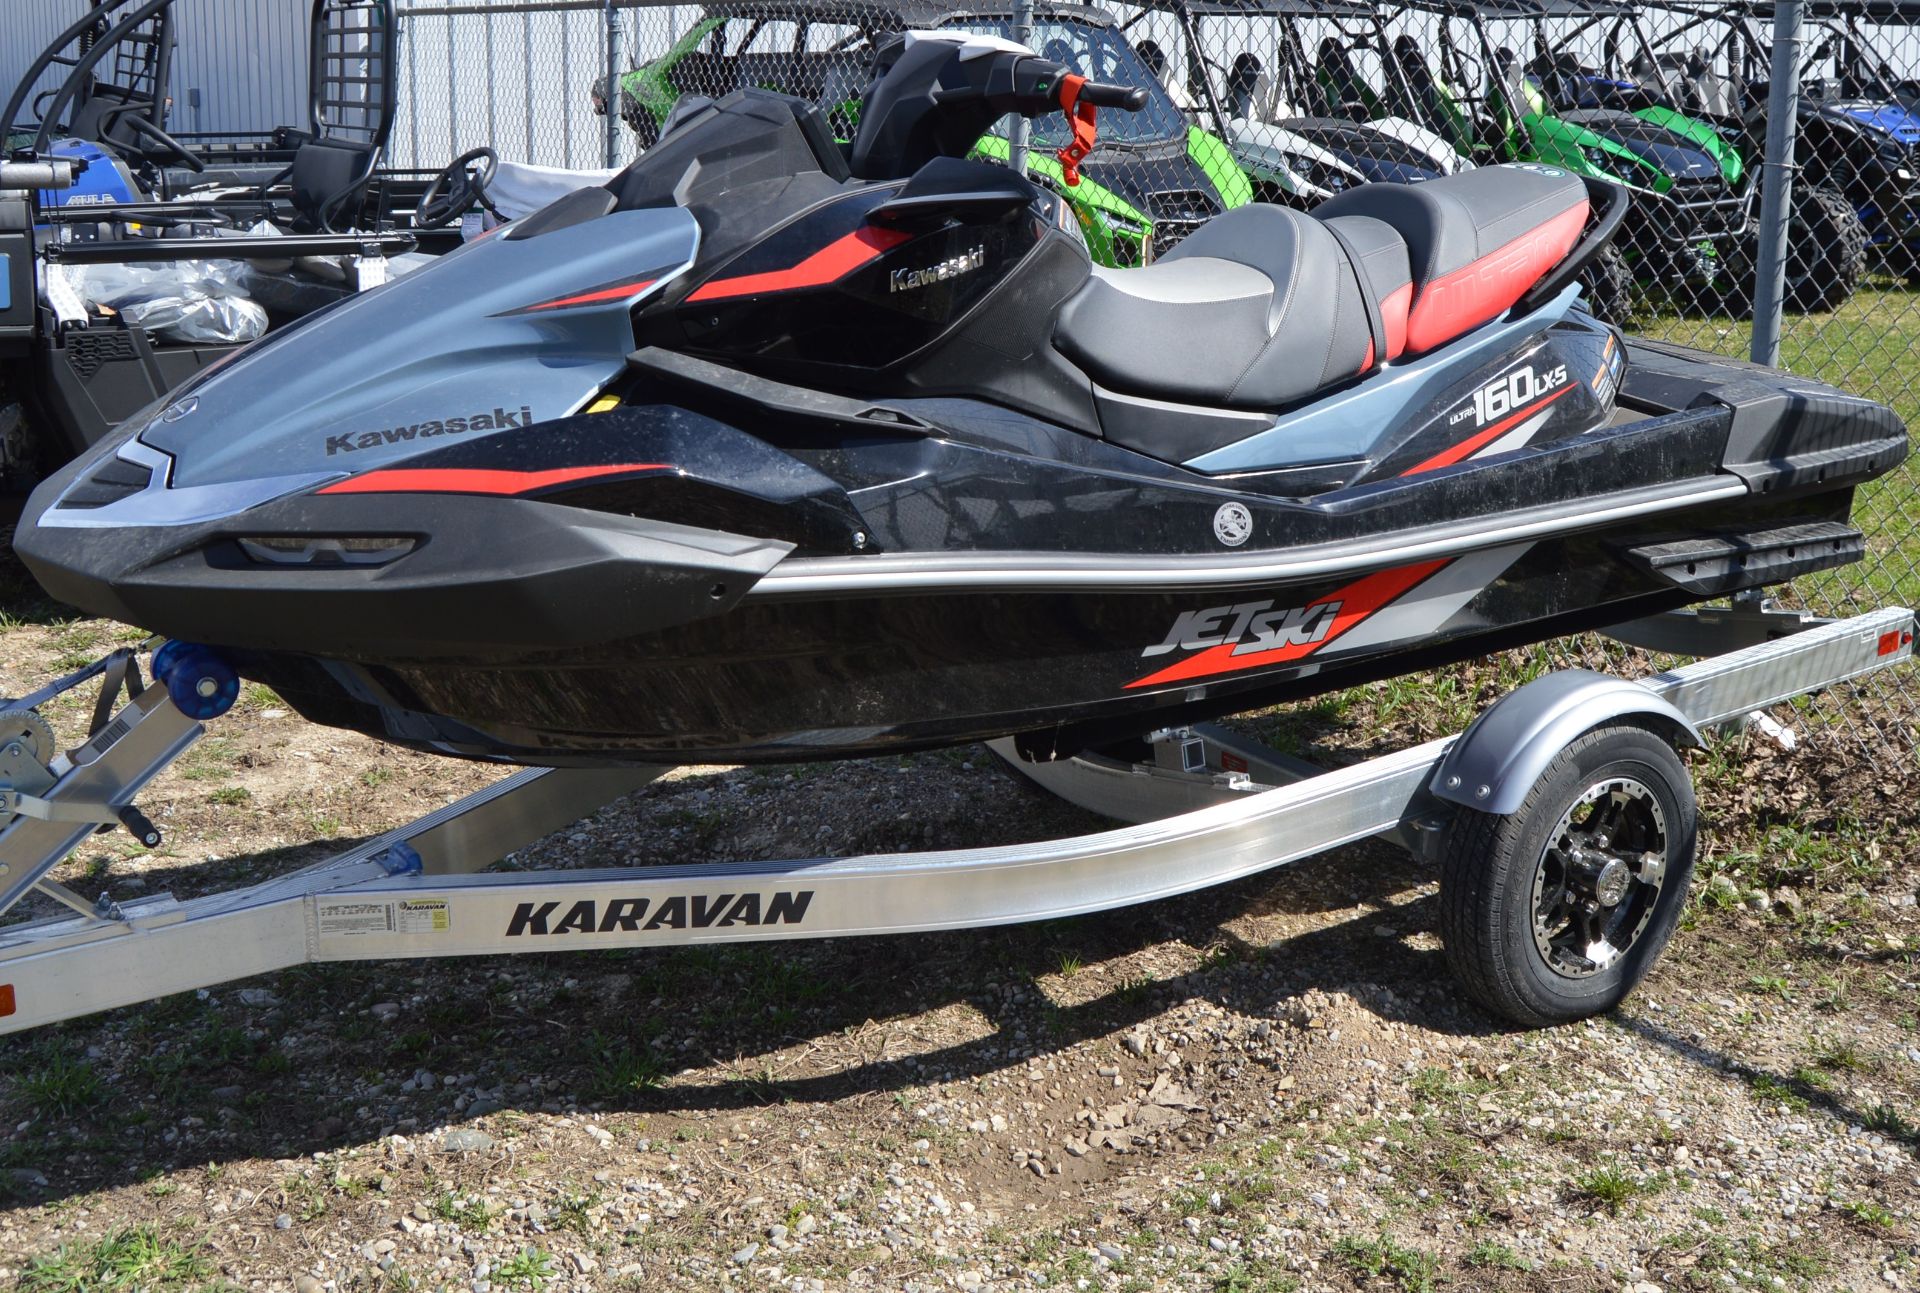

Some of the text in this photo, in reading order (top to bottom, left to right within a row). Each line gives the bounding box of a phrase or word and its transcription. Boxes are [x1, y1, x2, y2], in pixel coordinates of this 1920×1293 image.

[890, 244, 984, 293] Kawasaki
[1449, 406, 1476, 426] ULTRA
[1473, 365, 1535, 427] 160
[1534, 364, 1567, 396] LX-S
[326, 405, 533, 457] Kawasaki
[505, 890, 815, 937] KARAVAN
